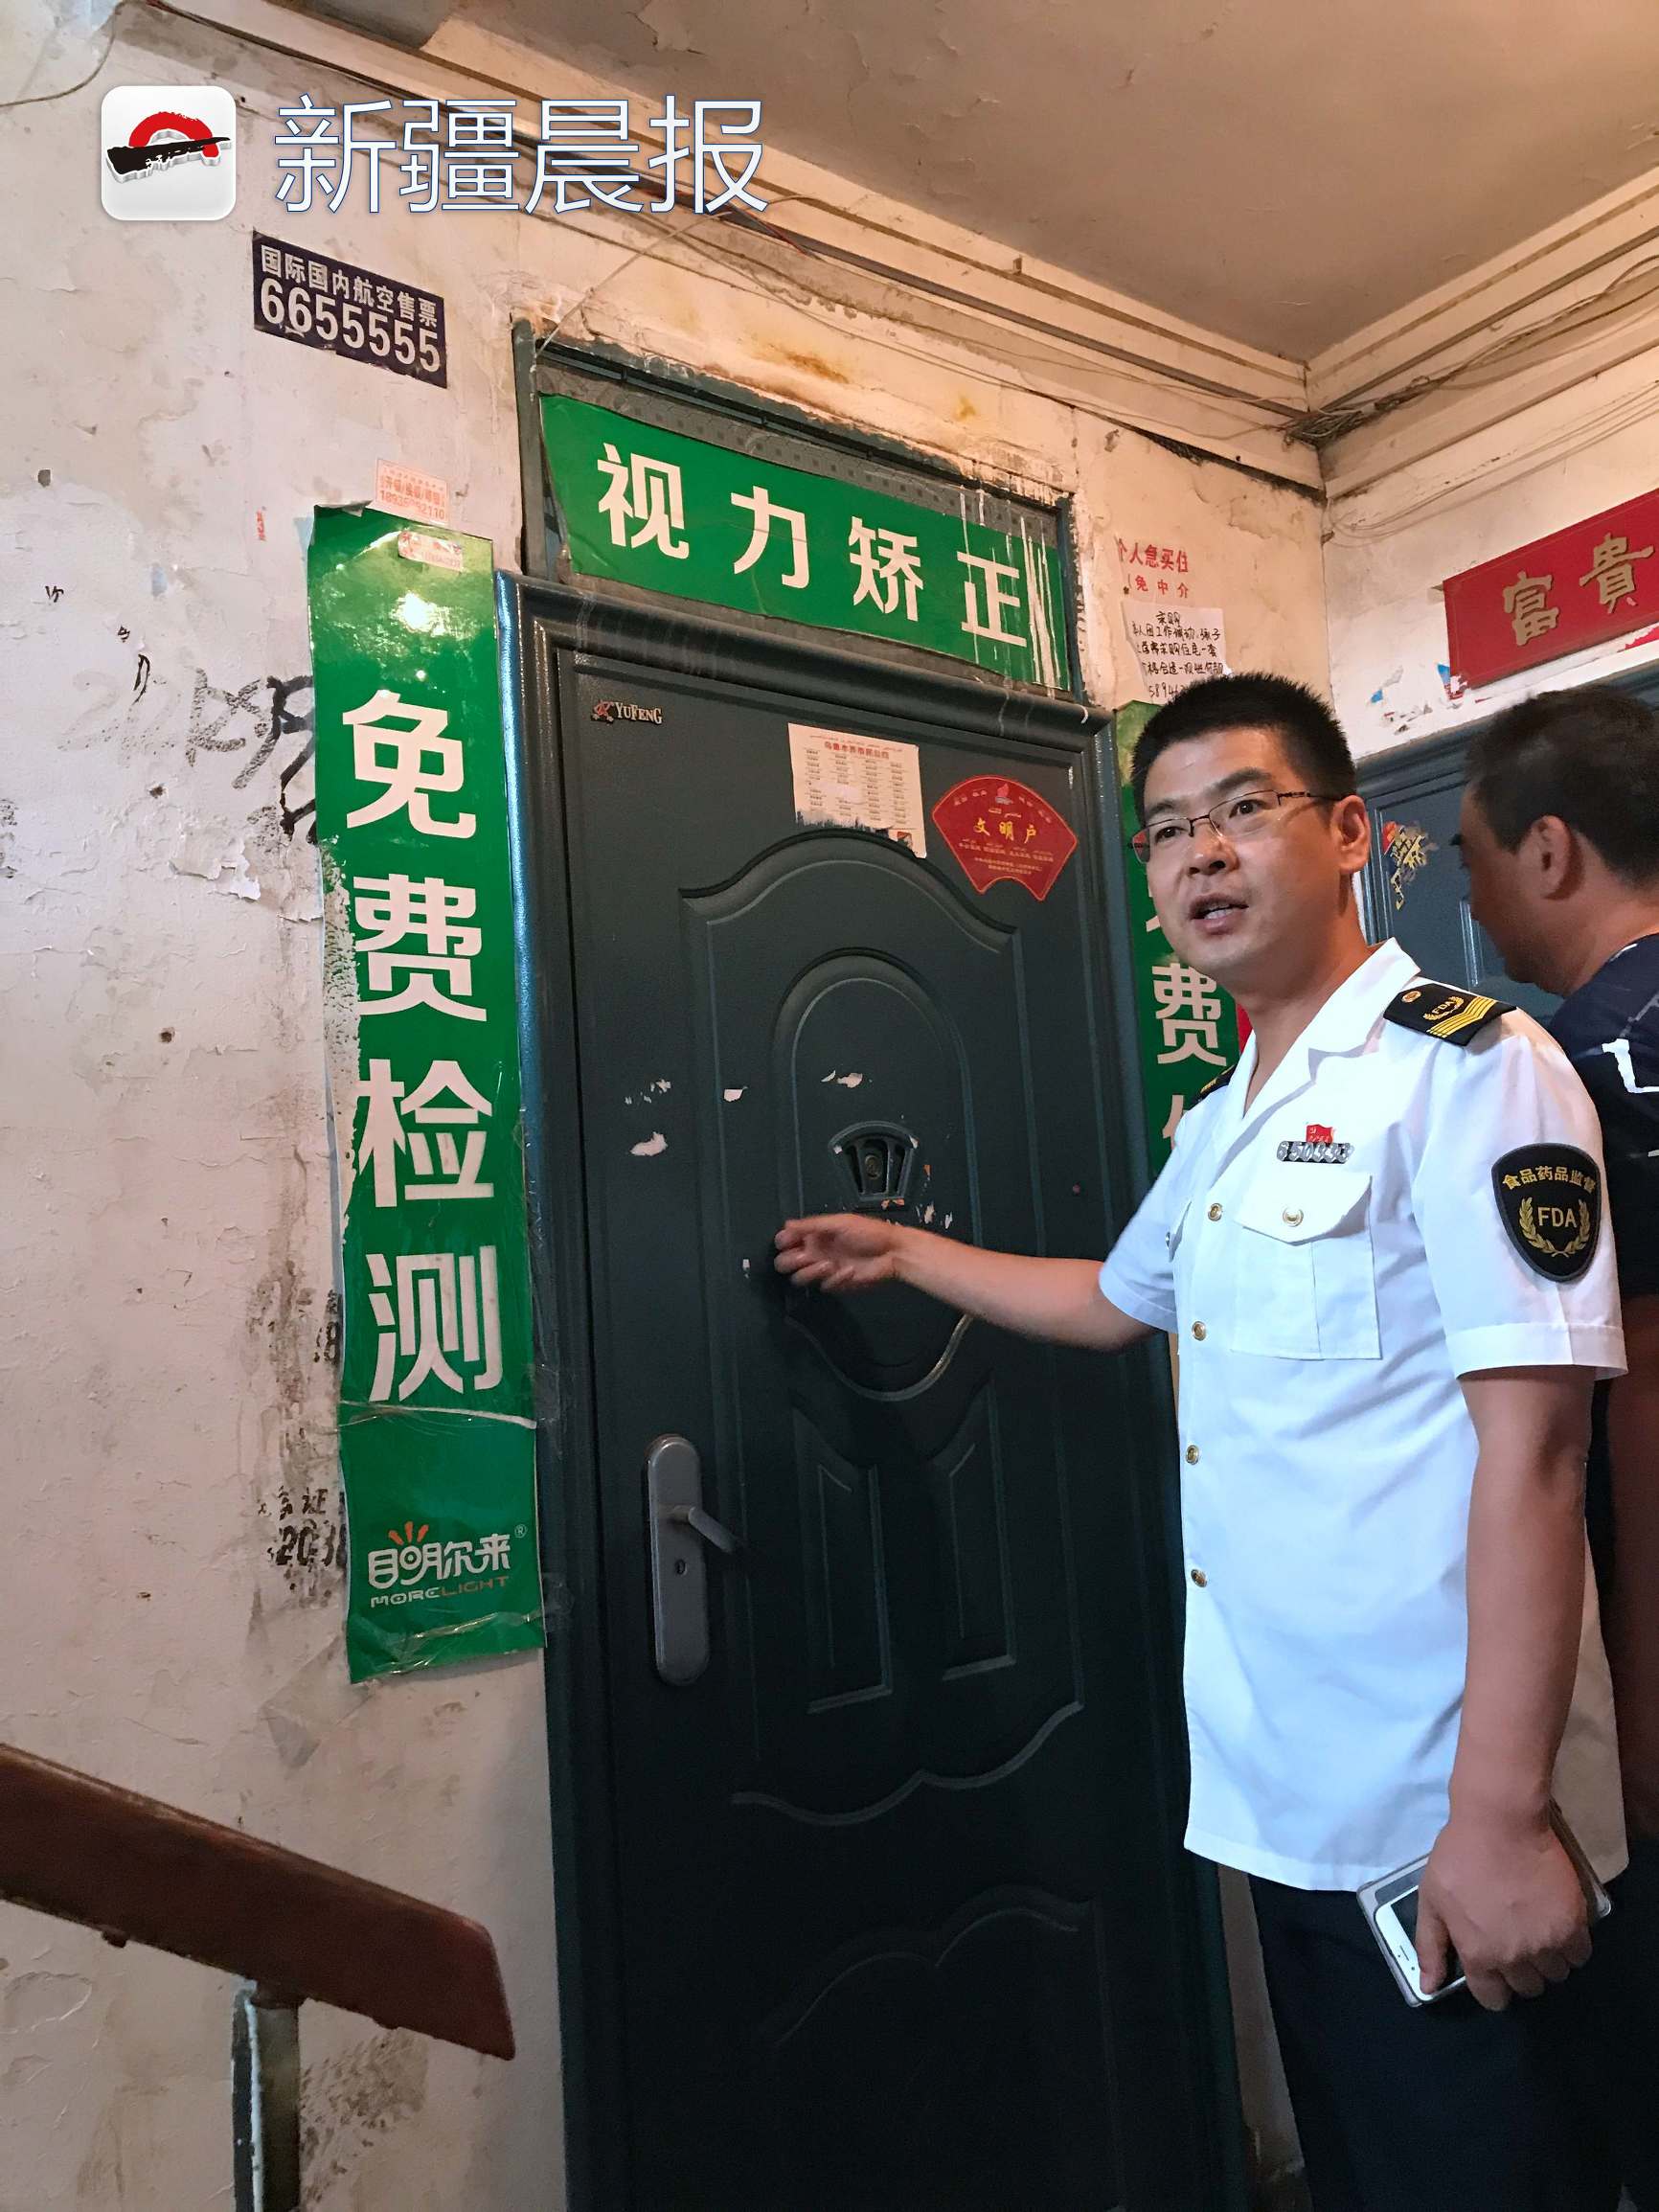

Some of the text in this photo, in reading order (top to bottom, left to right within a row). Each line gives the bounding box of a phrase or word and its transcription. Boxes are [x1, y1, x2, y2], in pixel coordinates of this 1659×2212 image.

[261, 244, 439, 328] 国际国内航空售票
[261, 277, 441, 373] 6655555
[597, 444, 1028, 648] 视力矫正
[973, 817, 1036, 844] 文明户
[1431, 1001, 1455, 1015] FDA
[341, 688, 502, 1402] 免费检测
[1502, 1165, 1597, 1194] 食品药品监督
[1537, 1206, 1579, 1228] FDA
[370, 1576, 510, 1608] MORELIGHT
